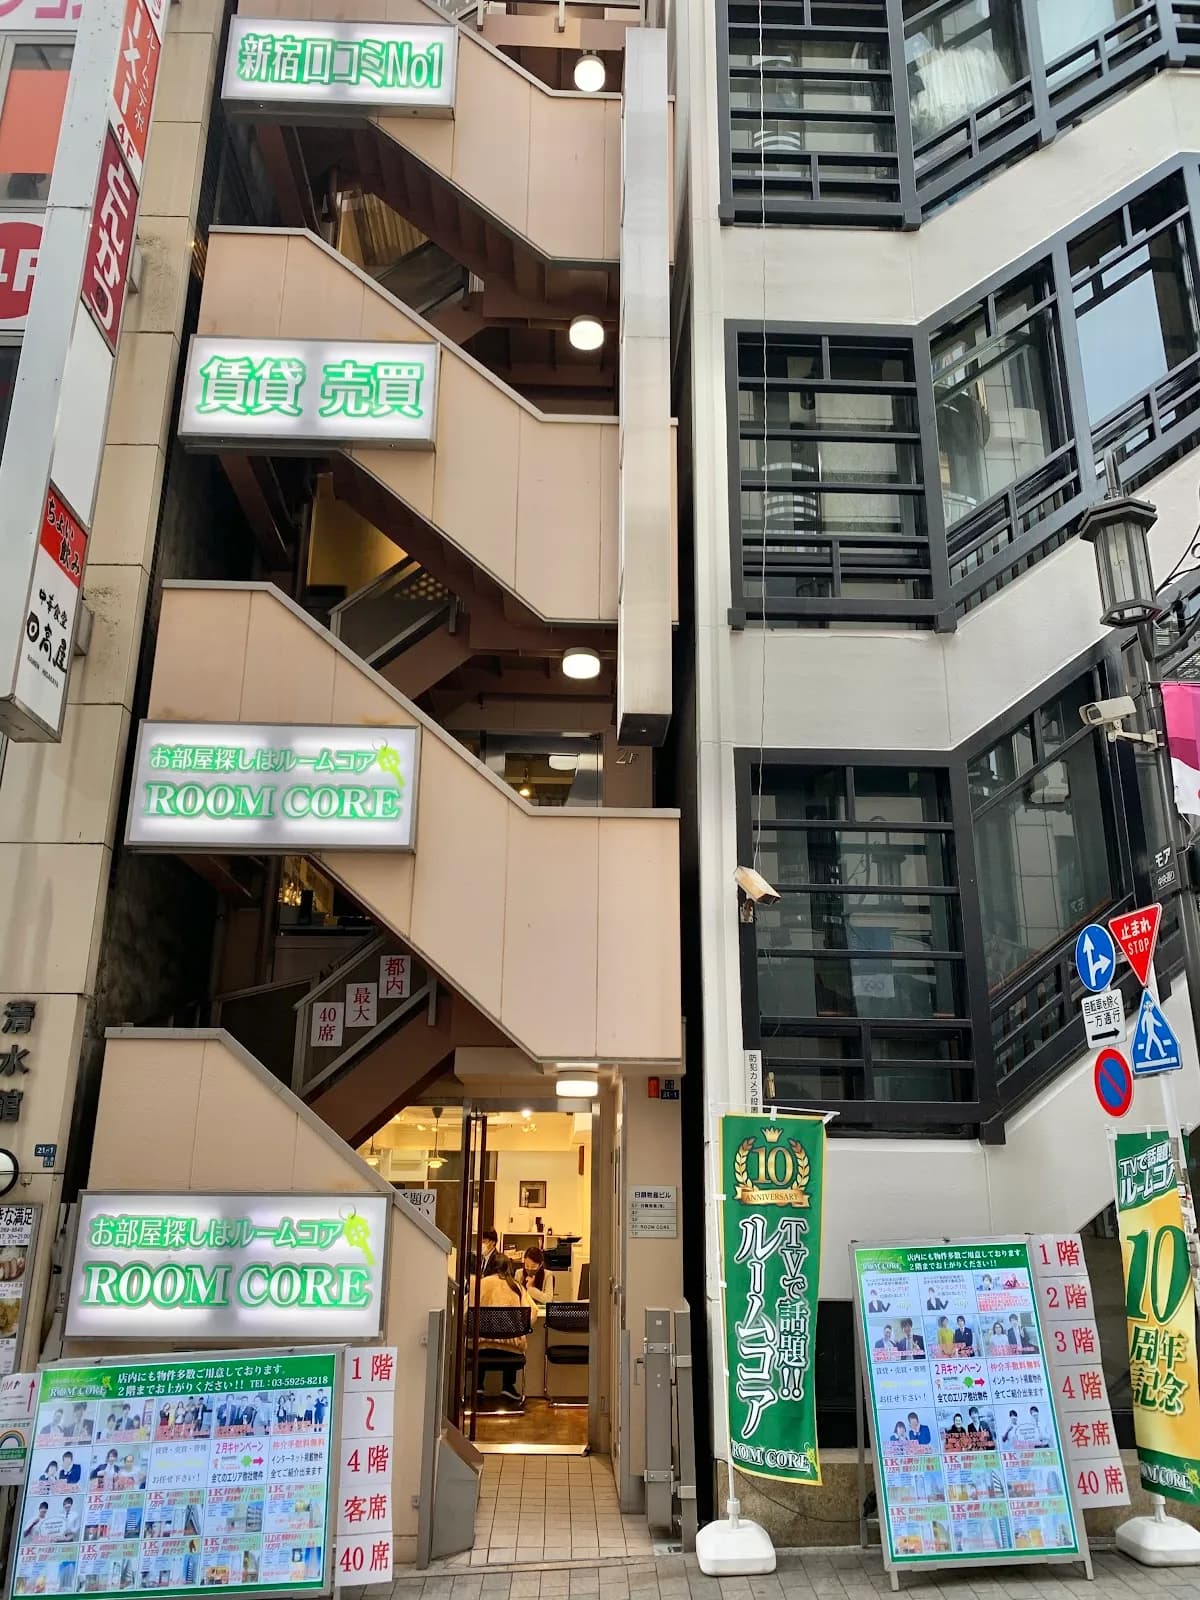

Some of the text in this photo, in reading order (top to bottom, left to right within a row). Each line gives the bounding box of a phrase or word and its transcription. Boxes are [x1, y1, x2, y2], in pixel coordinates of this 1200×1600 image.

[240, 34, 443, 88] 新宿口コミNo1
[91, 162, 131, 330] とんかつ
[197, 356, 424, 418] 賃貸 売買
[150, 746, 377, 772] お部屋探しはルームコア
[146, 785, 401, 820] ROOM CORE
[1155, 847, 1171, 867] モア
[1120, 916, 1151, 941] 止まれ
[1127, 940, 1150, 956] STOP
[385, 957, 405, 995] 都内
[353, 987, 371, 1023] 最大
[1084, 996, 1119, 1014] 自転車を除く
[1087, 1010, 1120, 1027] 一方通行
[751, 1147, 793, 1186] 10
[746, 1192, 799, 1202] ANNIVERSARY
[90, 1215, 343, 1249] お部屋探しはルームコア
[1039, 1240, 1080, 1267] 1階
[83, 1263, 371, 1307] ROOM CORE
[1126, 1225, 1191, 1322] 10
[778, 1219, 809, 1398] TVで話題!!
[1046, 1283, 1088, 1310] 2階
[736, 1216, 783, 1437] ルームコア
[1054, 1327, 1095, 1354] 3階
[117, 1363, 285, 1384] 店内にも物件多数ご用意しております。
[351, 1353, 393, 1382] 1階
[935, 1364, 982, 1375] 2月キャンペーン
[118, 1379, 244, 1397] 2階までお上がりください!!
[1062, 1371, 1102, 1401] 4階
[1070, 1420, 1110, 1448] 客席
[347, 1444, 389, 1473] 4階
[766, 1449, 810, 1471] CORE
[1077, 1465, 1124, 1495] 40席
[343, 1493, 387, 1524] 客席
[339, 1540, 390, 1572] 40席
